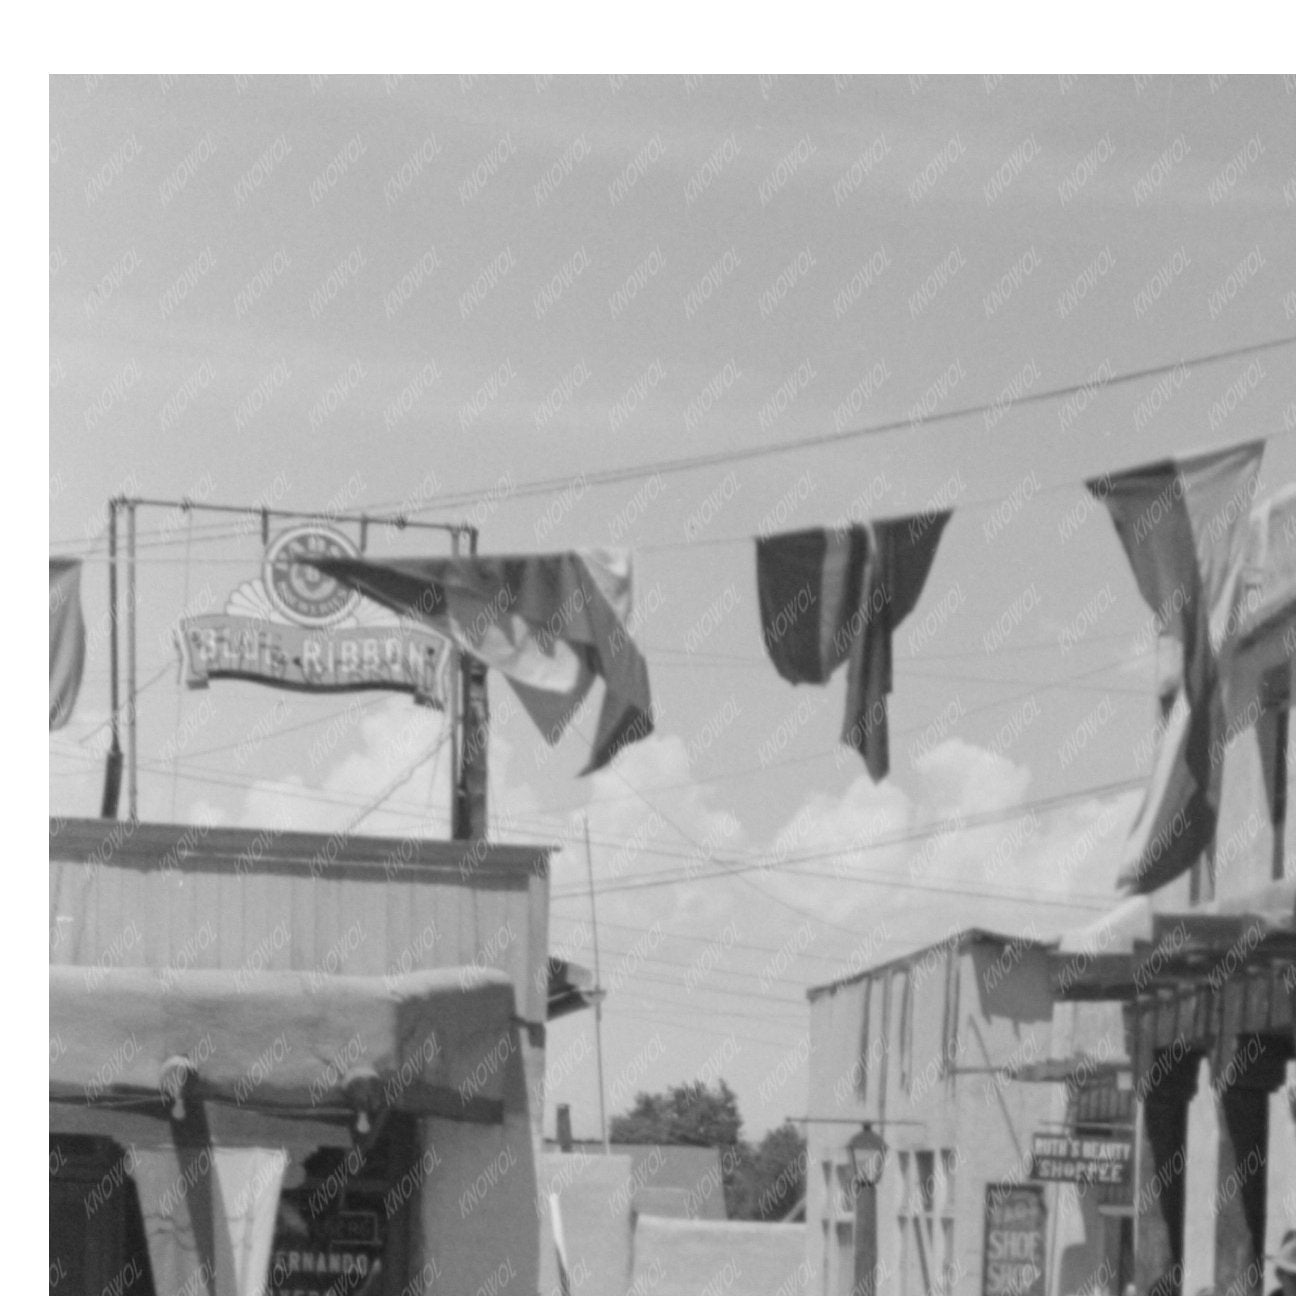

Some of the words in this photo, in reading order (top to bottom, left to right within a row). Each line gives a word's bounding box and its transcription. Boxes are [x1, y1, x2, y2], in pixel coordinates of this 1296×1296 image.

[192, 626, 286, 669] BLUE
[302, 636, 428, 675] RIBBON
[1035, 1137, 1080, 1158] RUTH'S
[1082, 1140, 1132, 1160] BEAUTY
[988, 1230, 1041, 1261] SHOE
